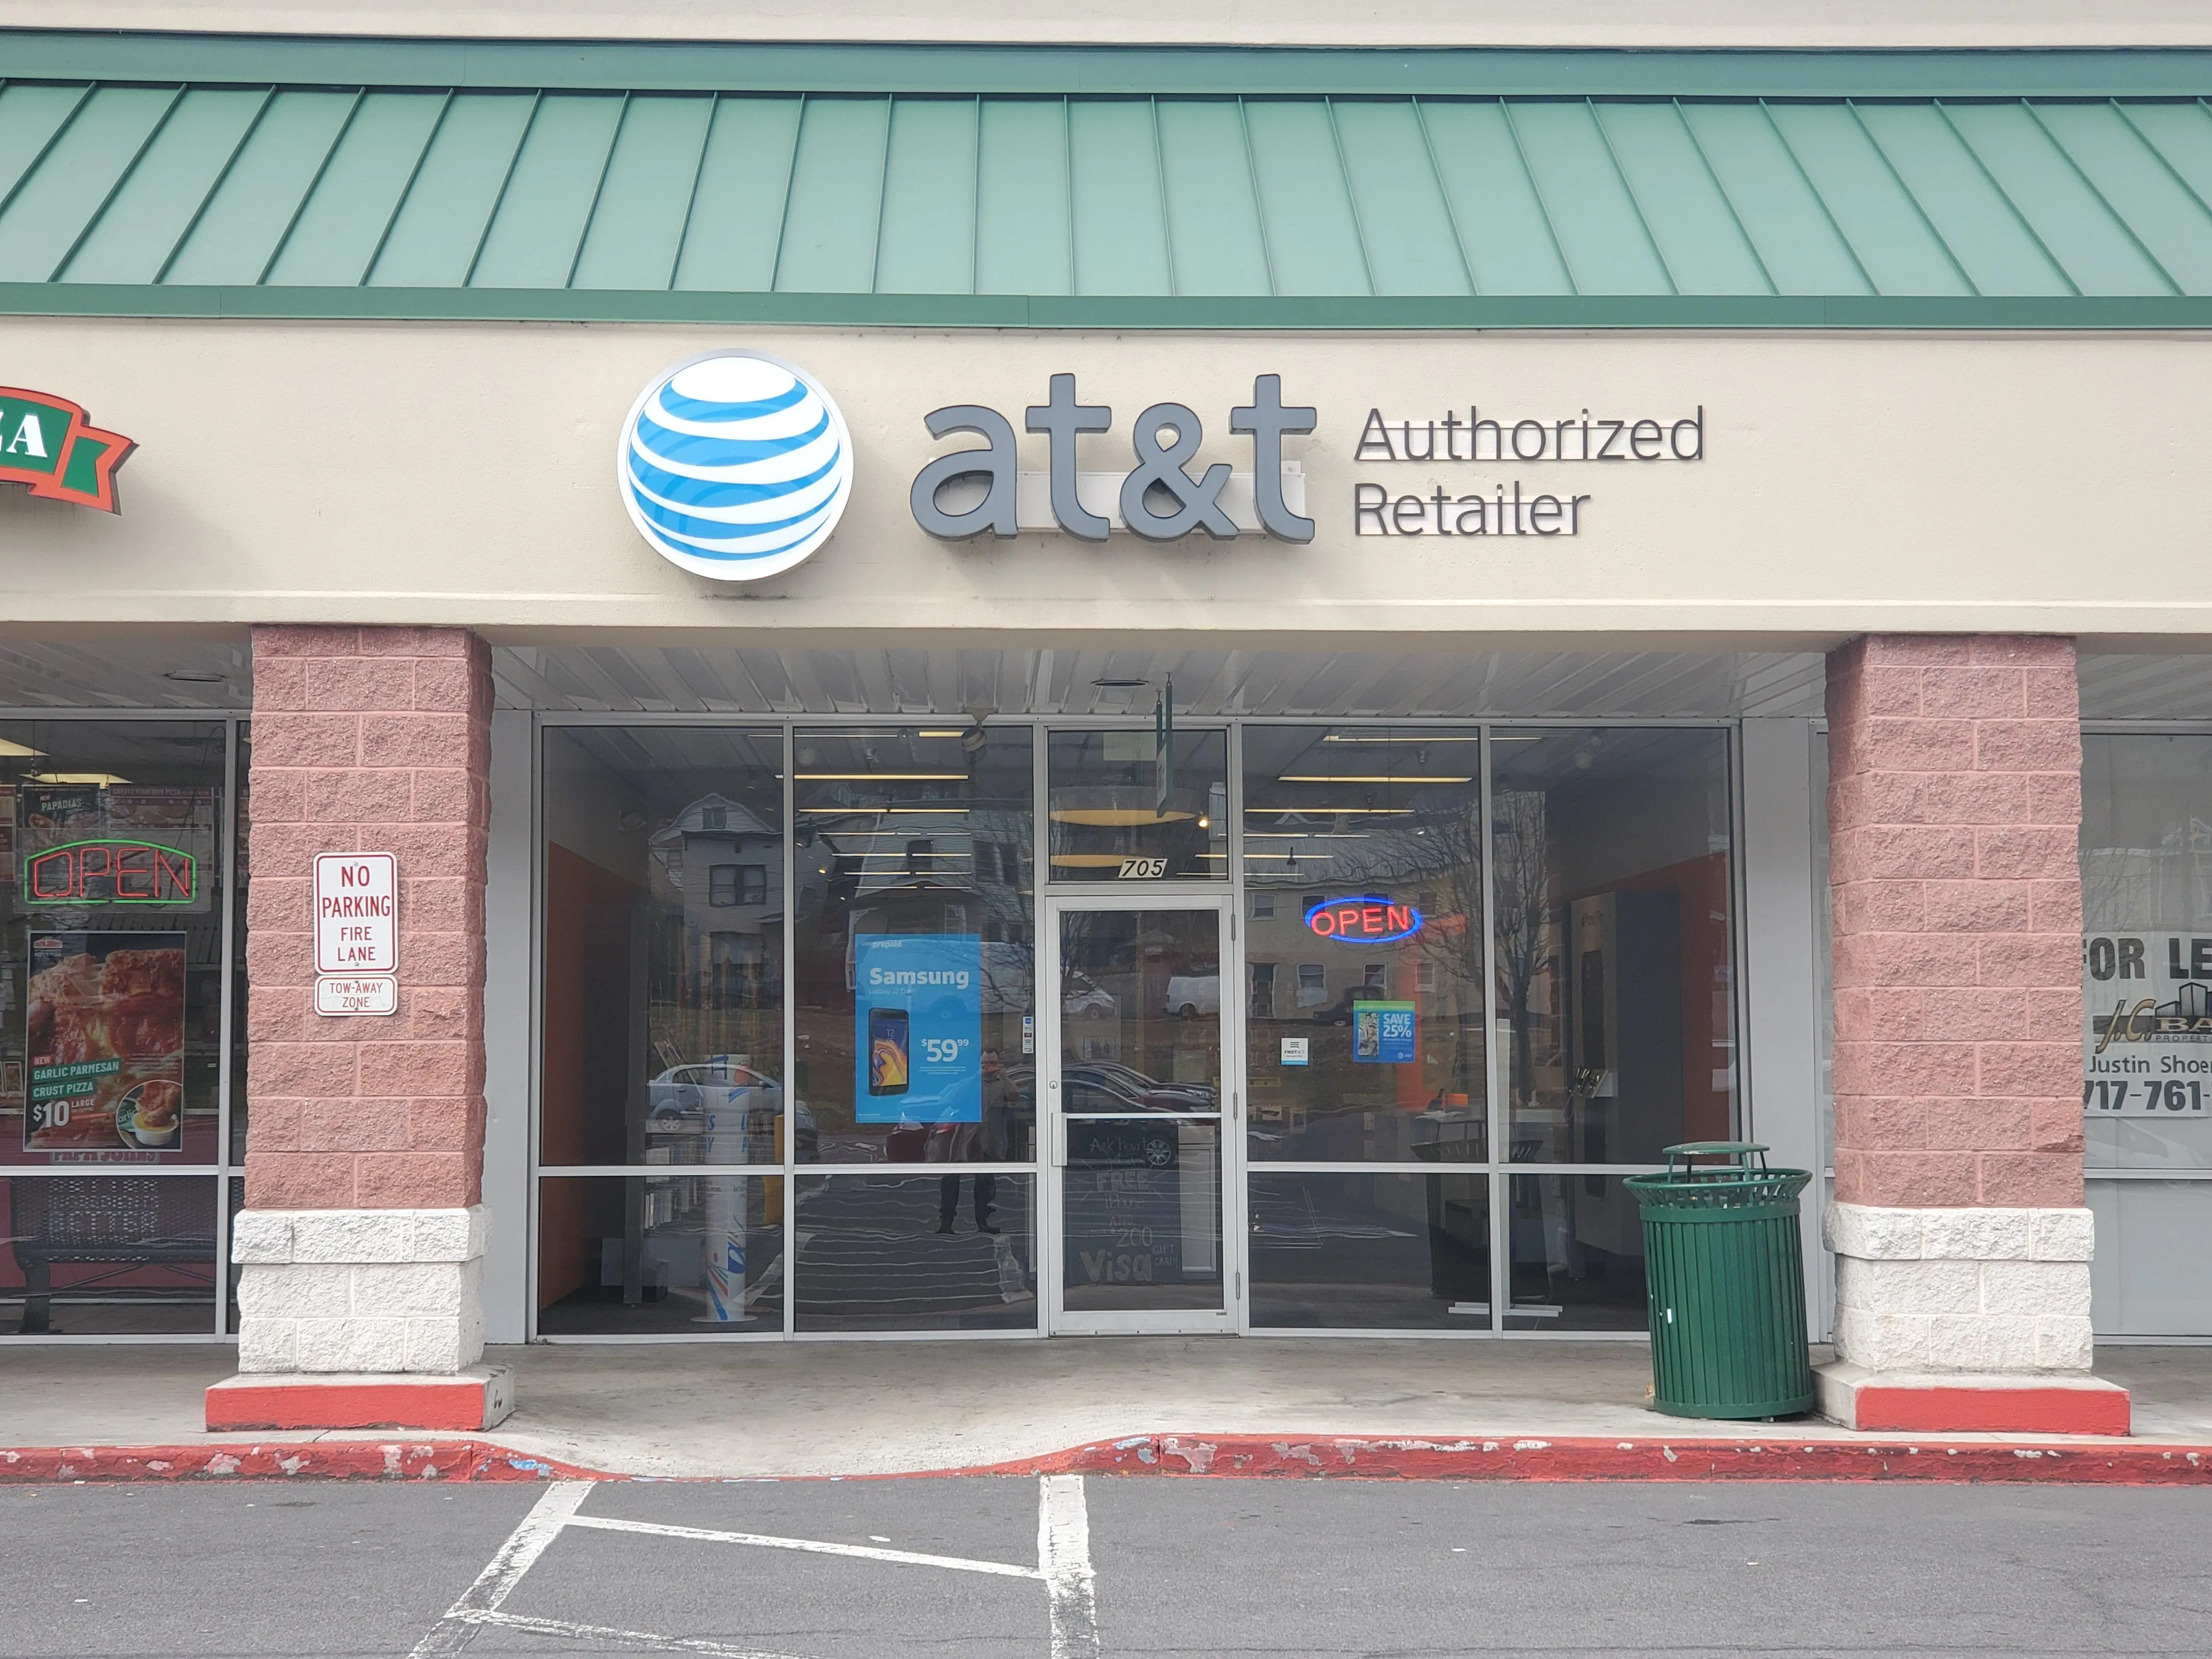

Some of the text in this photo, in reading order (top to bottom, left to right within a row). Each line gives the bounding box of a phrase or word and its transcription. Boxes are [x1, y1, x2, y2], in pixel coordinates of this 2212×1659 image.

[0, 409, 48, 458] A
[1354, 405, 1703, 461] Authorized
[1355, 481, 1591, 536] Retailer
[42, 799, 82, 811] PAPADIAS
[33, 847, 189, 898] OPEN
[341, 866, 370, 887] NO
[1122, 860, 1164, 877] 705
[322, 895, 391, 918] PARKING
[1311, 906, 1409, 936] OPEN
[341, 926, 372, 941] FIRE
[338, 946, 376, 962] LANE
[870, 967, 969, 989] Samsung
[330, 983, 383, 994] TOW-AWAY
[342, 997, 370, 1008] ZONE
[1383, 1013, 1411, 1025] SAVE
[886, 1029, 895, 1037] 12
[1383, 1024, 1412, 1038] 25%
[35, 1056, 50, 1065] NEW
[2089, 1054, 2212, 1074] Justin Shoe
[34, 1067, 68, 1080] GARLIC
[70, 1061, 119, 1076] PARMESAN
[33, 1082, 93, 1097] CRUST PIZZA
[2084, 1080, 2212, 1111] 717-761-
[71, 1098, 95, 1108] LARGE
[33, 1101, 69, 1128] $10
[1090, 1136, 1114, 1154] Ask
[1118, 1136, 1140, 1151] how
[1097, 1171, 1149, 1192] FREE
[1105, 1193, 1145, 1209] iPhone
[1152, 1244, 1175, 1255] GIFT
[1079, 1249, 1152, 1282] Visa
